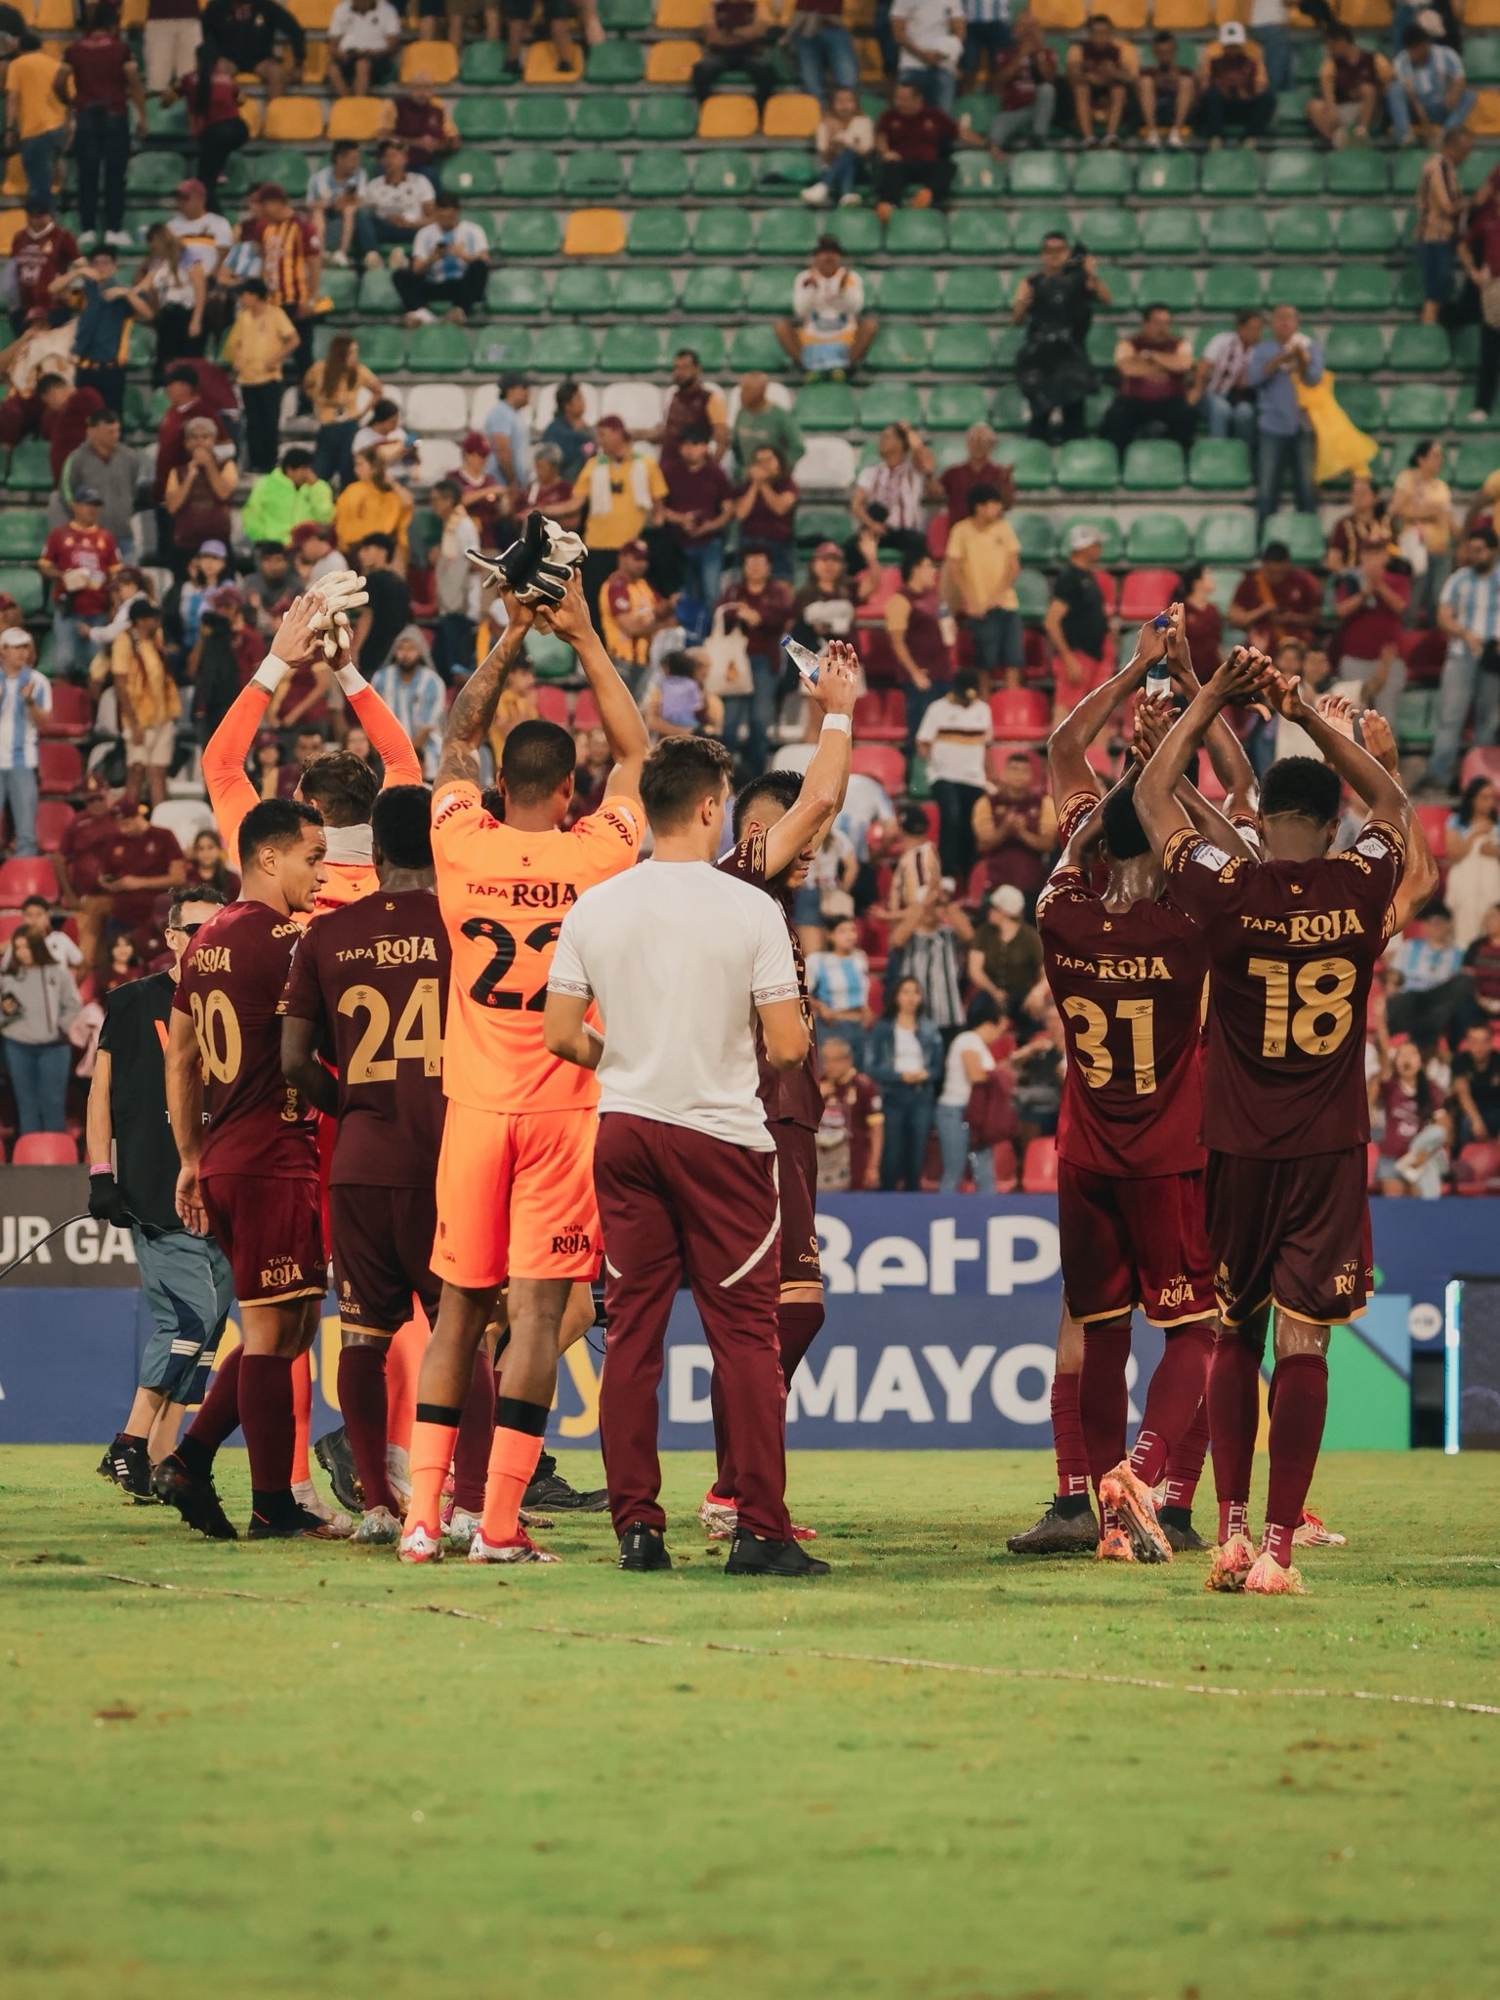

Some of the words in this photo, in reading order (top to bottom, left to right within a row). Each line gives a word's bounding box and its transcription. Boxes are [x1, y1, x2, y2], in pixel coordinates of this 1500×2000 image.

[466, 883, 509, 899] TAPA
[511, 882, 578, 908] ROJA
[1241, 915, 1287, 935] TAPA
[1288, 909, 1365, 943] ROJA
[195, 946, 232, 973] ROJA
[336, 948, 375, 962] TAPA
[375, 936, 438, 966] ROJA
[1055, 953, 1096, 973] TAPA
[1097, 956, 1173, 982] ROJA
[1248, 957, 1357, 1058] 18
[337, 978, 446, 1085] 24
[1061, 995, 1157, 1095] 31
[563, 1225, 583, 1234] TAPA
[551, 1233, 590, 1254] ROJA
[268, 1256, 294, 1266] TAPA
[260, 1263, 304, 1288] ROJA
[1158, 1283, 1195, 1307] ROJA
